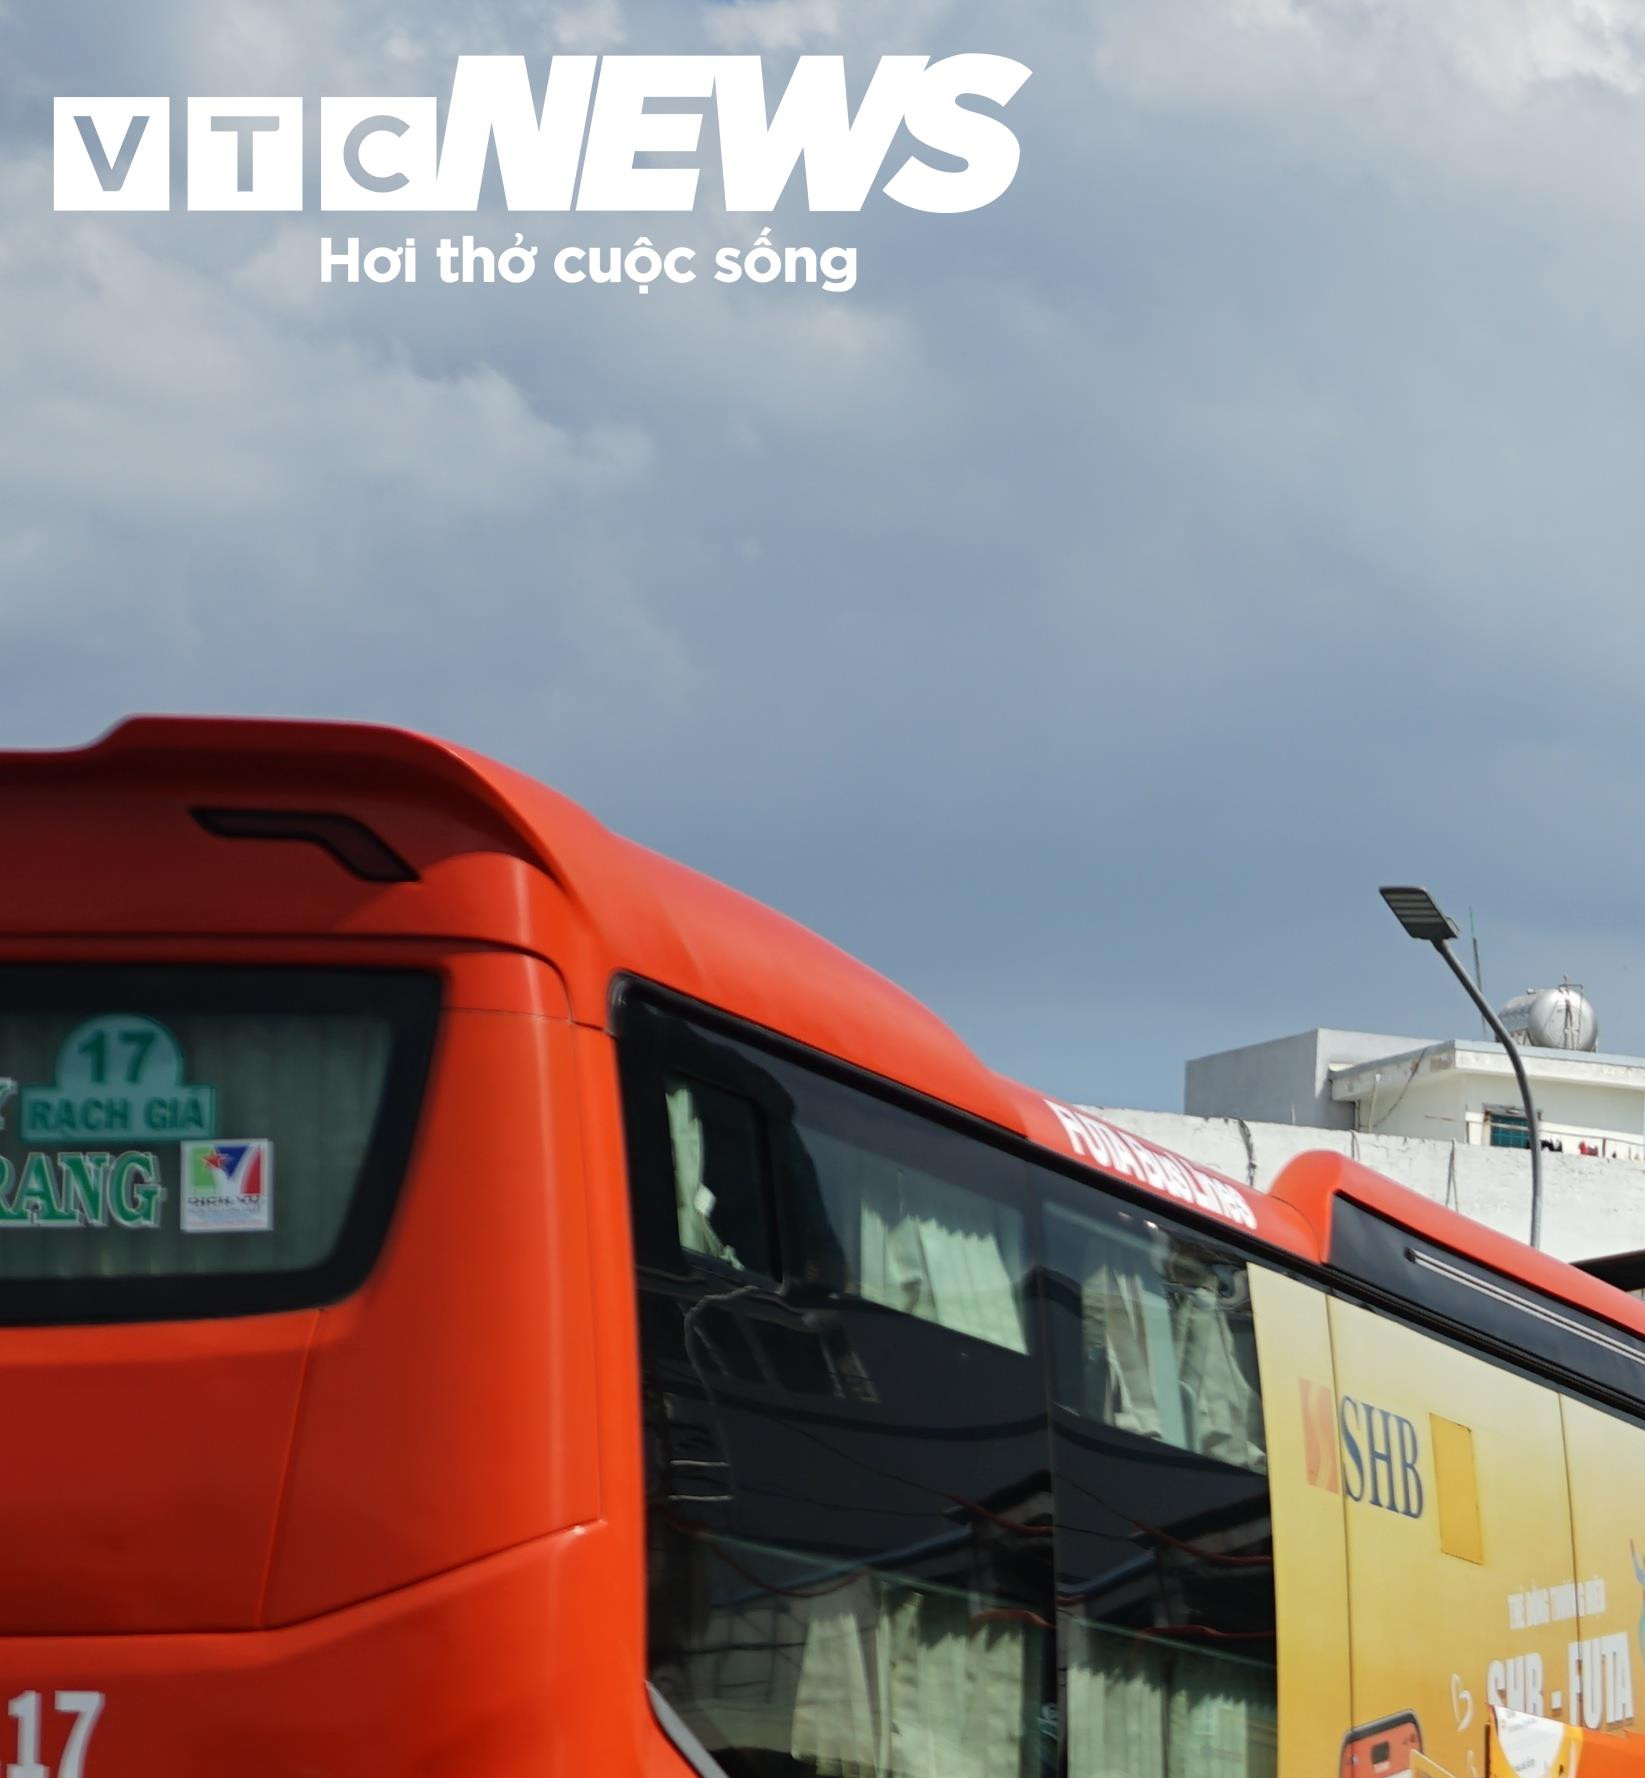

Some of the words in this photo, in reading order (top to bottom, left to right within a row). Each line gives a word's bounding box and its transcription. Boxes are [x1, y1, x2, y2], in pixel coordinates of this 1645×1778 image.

[77, 1030, 158, 1085] 17
[1339, 1393, 1424, 1521] SHB
[1567, 1631, 1634, 1729] FUTA
